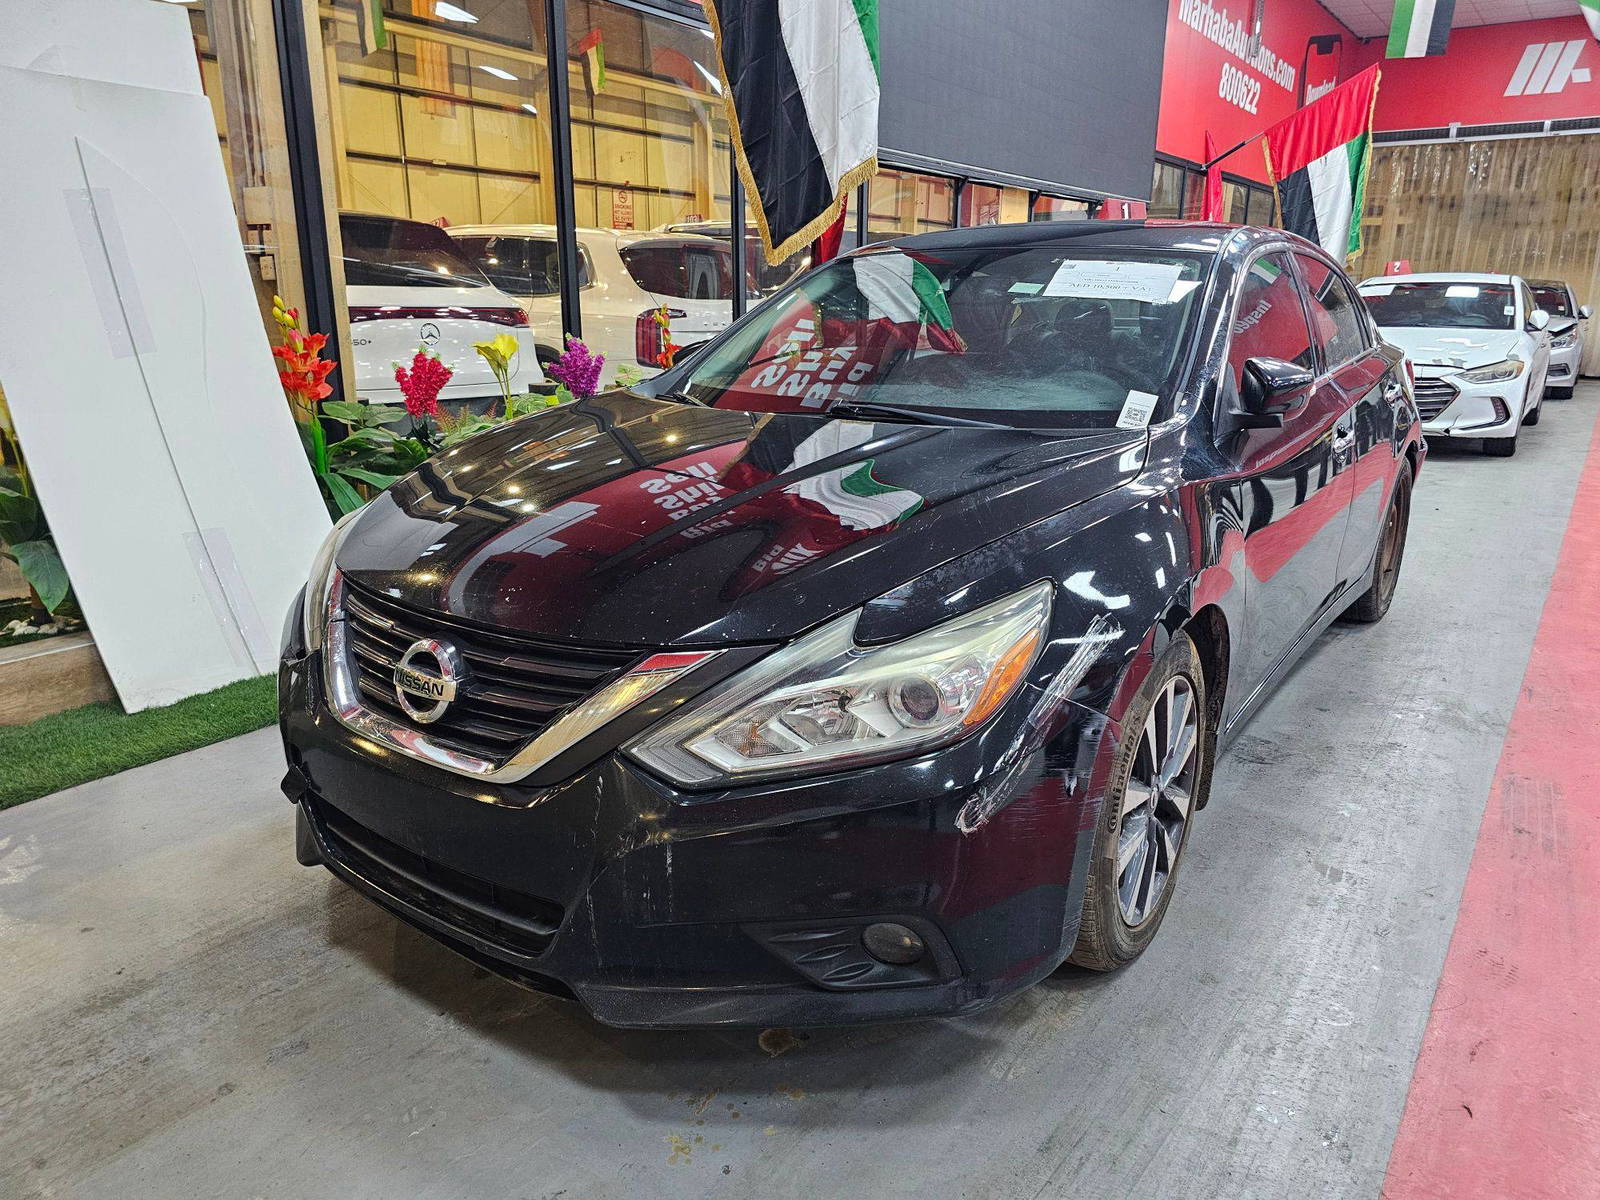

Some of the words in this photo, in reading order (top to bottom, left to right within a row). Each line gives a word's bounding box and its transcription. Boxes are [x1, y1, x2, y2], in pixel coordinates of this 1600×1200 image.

[1218, 62, 1260, 115] 800622
[1122, 202, 1129, 219] 1
[1393, 261, 1400, 273] 2
[396, 667, 444, 697] NISSAN
